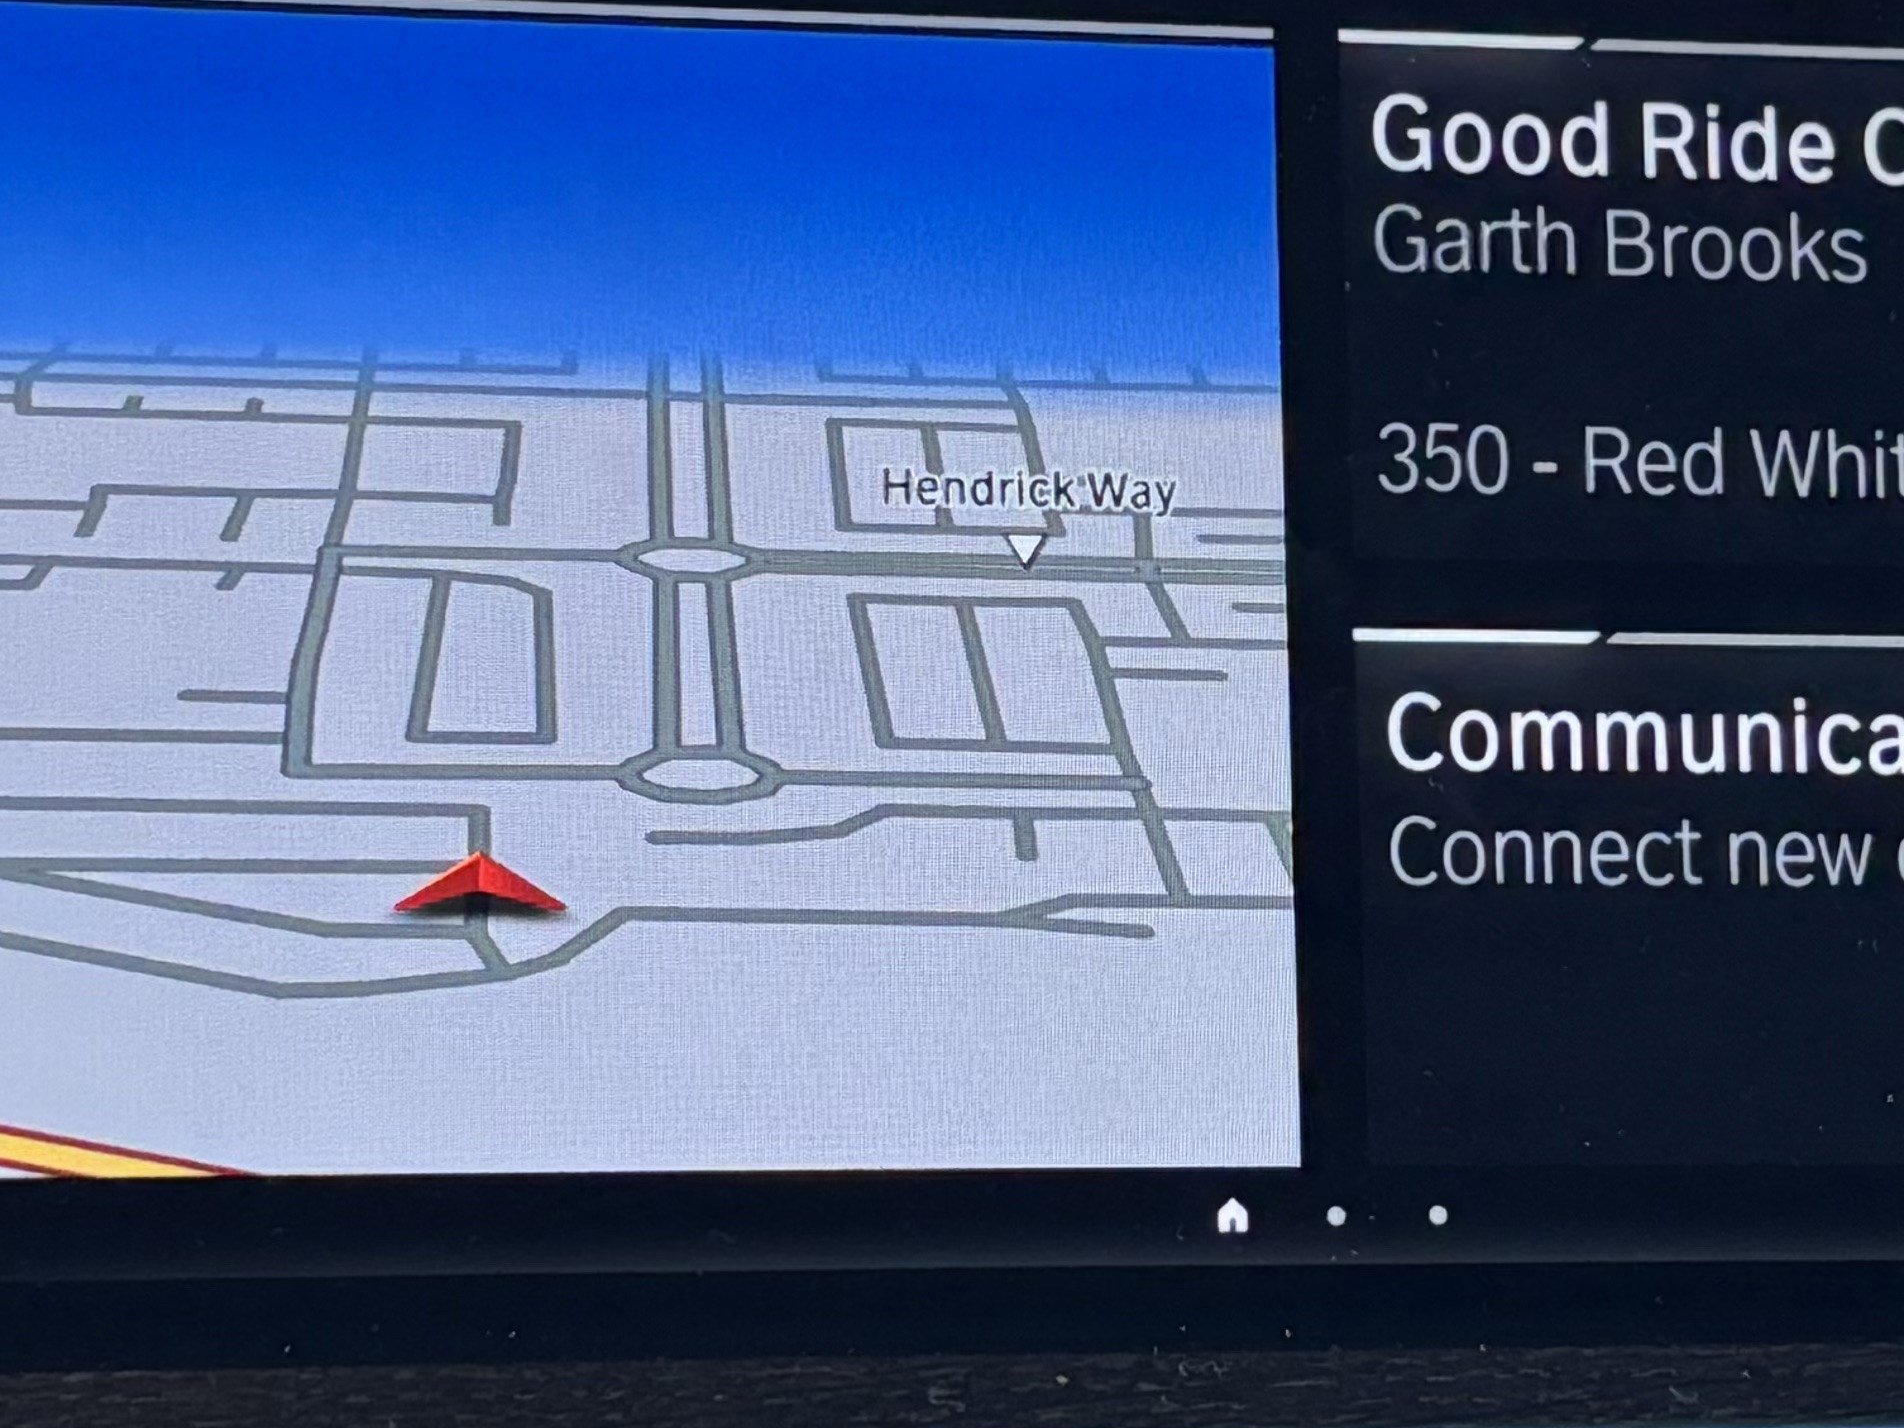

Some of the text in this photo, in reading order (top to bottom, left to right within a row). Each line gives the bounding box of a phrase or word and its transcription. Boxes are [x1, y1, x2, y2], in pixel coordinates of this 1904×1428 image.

[1372, 92, 1609, 178] Good
[1642, 102, 1835, 184] Ride
[1374, 203, 1867, 284] Garth Brooks
[883, 466, 1177, 516] Hendrick Way
[1378, 422, 1509, 495] 350
[1585, 426, 1724, 496] Red
[1390, 815, 1703, 887] Connect
[1729, 831, 1872, 888] new
